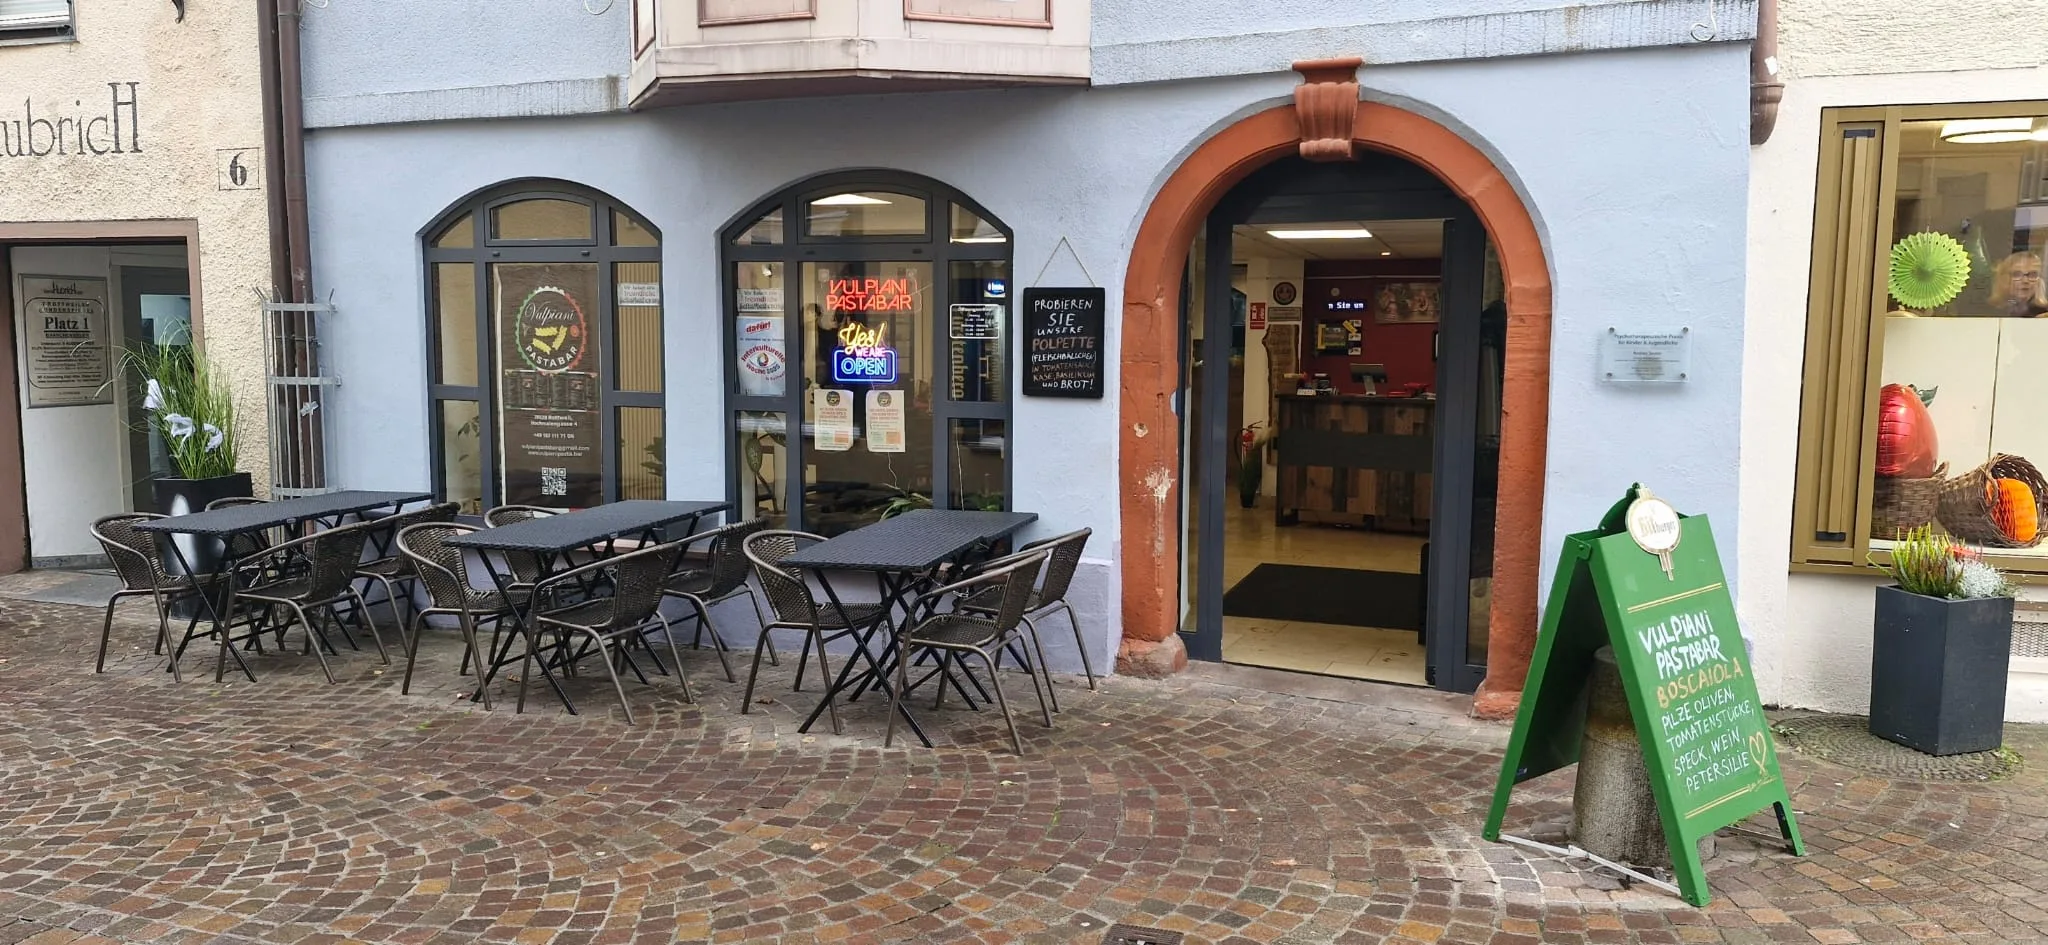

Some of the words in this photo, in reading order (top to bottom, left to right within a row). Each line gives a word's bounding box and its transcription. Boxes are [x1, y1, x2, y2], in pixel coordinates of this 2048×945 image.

[0, 82, 143, 157] ubricH
[229, 151, 248, 187] 6
[830, 278, 907, 295] VULPIANI
[825, 294, 912, 311] PASTABAR
[525, 301, 576, 326] Vulpiani
[44, 316, 79, 330] Platz
[83, 317, 89, 330] 1
[746, 321, 771, 333] dafür!
[840, 322, 886, 355] Yes!
[1032, 336, 1096, 351] POLPETTE
[525, 345, 578, 367] PASTABAR
[740, 344, 785, 363] Interkulturelle
[854, 347, 869, 357] WE
[869, 347, 886, 357] ARE
[841, 357, 887, 375] OPEN
[1060, 379, 1093, 390] BROT!
[1655, 634, 1729, 680] PASTABAR
[1674, 746, 1712, 776] SPECK,
